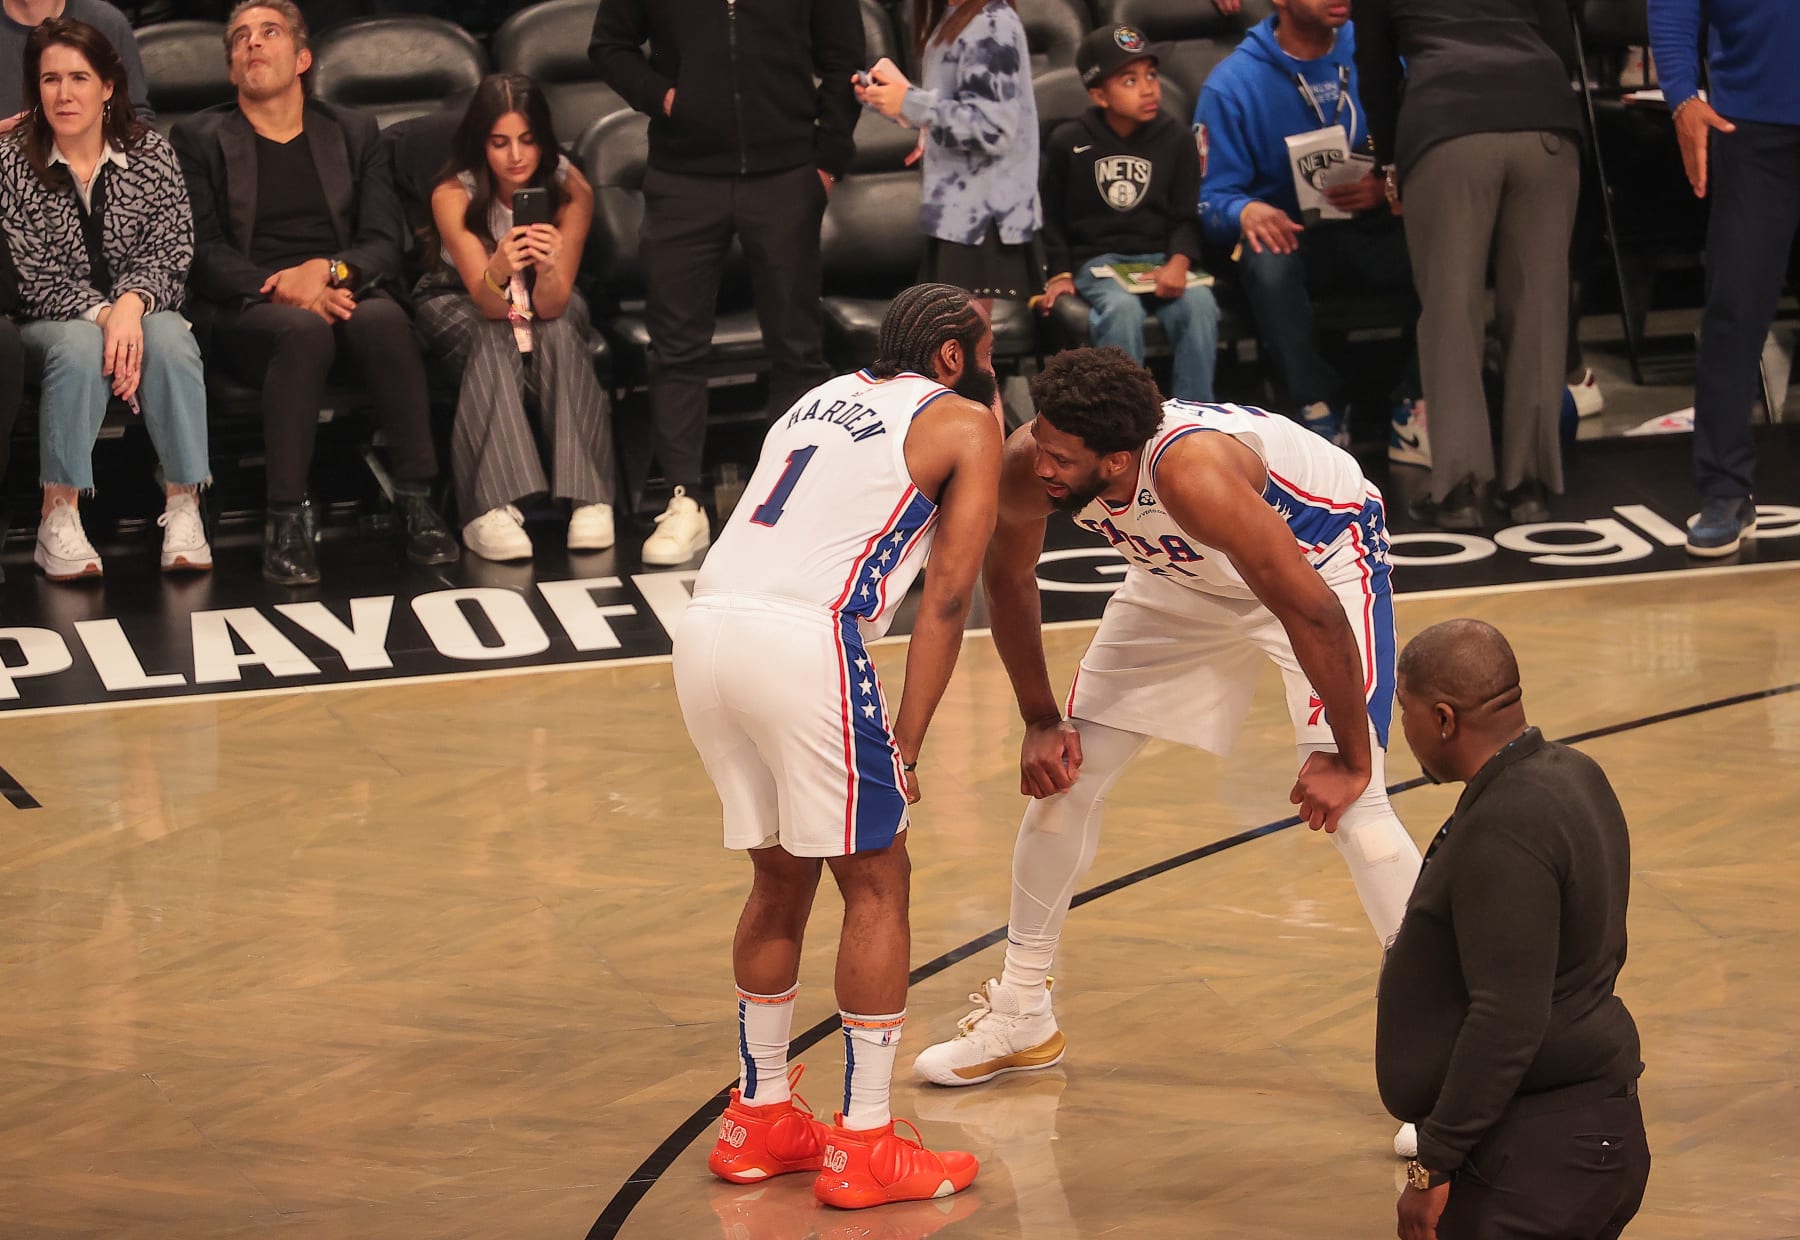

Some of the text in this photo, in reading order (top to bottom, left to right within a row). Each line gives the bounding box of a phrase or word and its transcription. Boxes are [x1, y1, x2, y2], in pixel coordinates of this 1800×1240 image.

[1099, 159, 1149, 184] NETS
[787, 399, 886, 443] HARDEN
[750, 445, 819, 528] 1
[1036, 504, 1800, 592] Gogle
